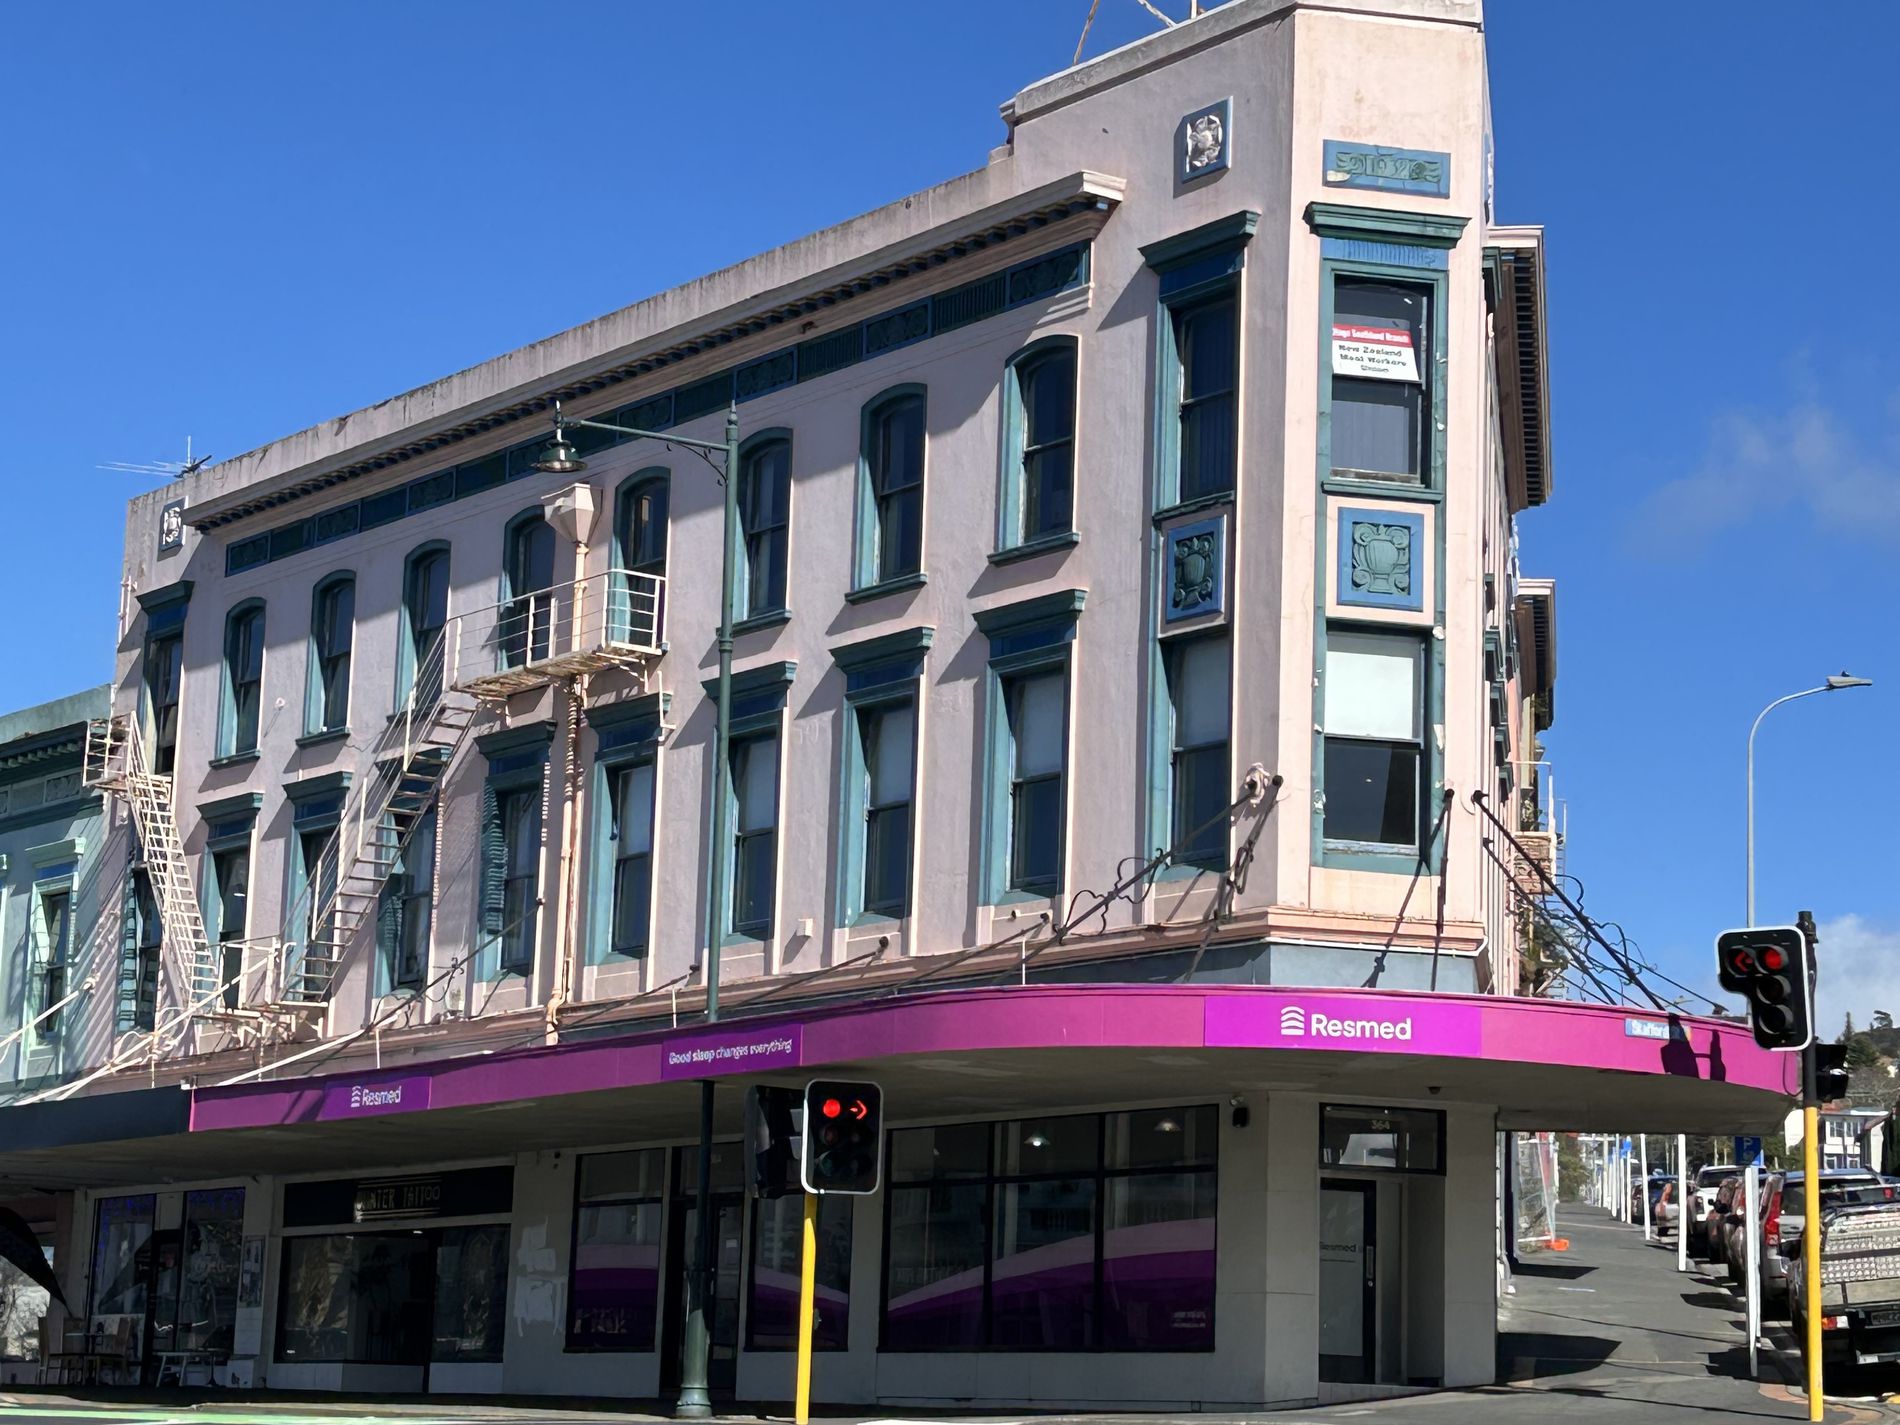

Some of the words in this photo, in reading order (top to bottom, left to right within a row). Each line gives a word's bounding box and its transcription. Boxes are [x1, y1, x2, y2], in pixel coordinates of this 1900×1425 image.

[1362, 346, 1402, 357] Zealand
[1367, 356, 1406, 367] Workers
[1311, 1014, 1412, 1041] Resmed
[668, 1051, 692, 1065] Good
[692, 1049, 715, 1063] sleep
[716, 1046, 749, 1060] changes
[750, 1038, 792, 1056] everything
[361, 1085, 402, 1106] Resmed
[401, 1185, 441, 1209] TATTOO
